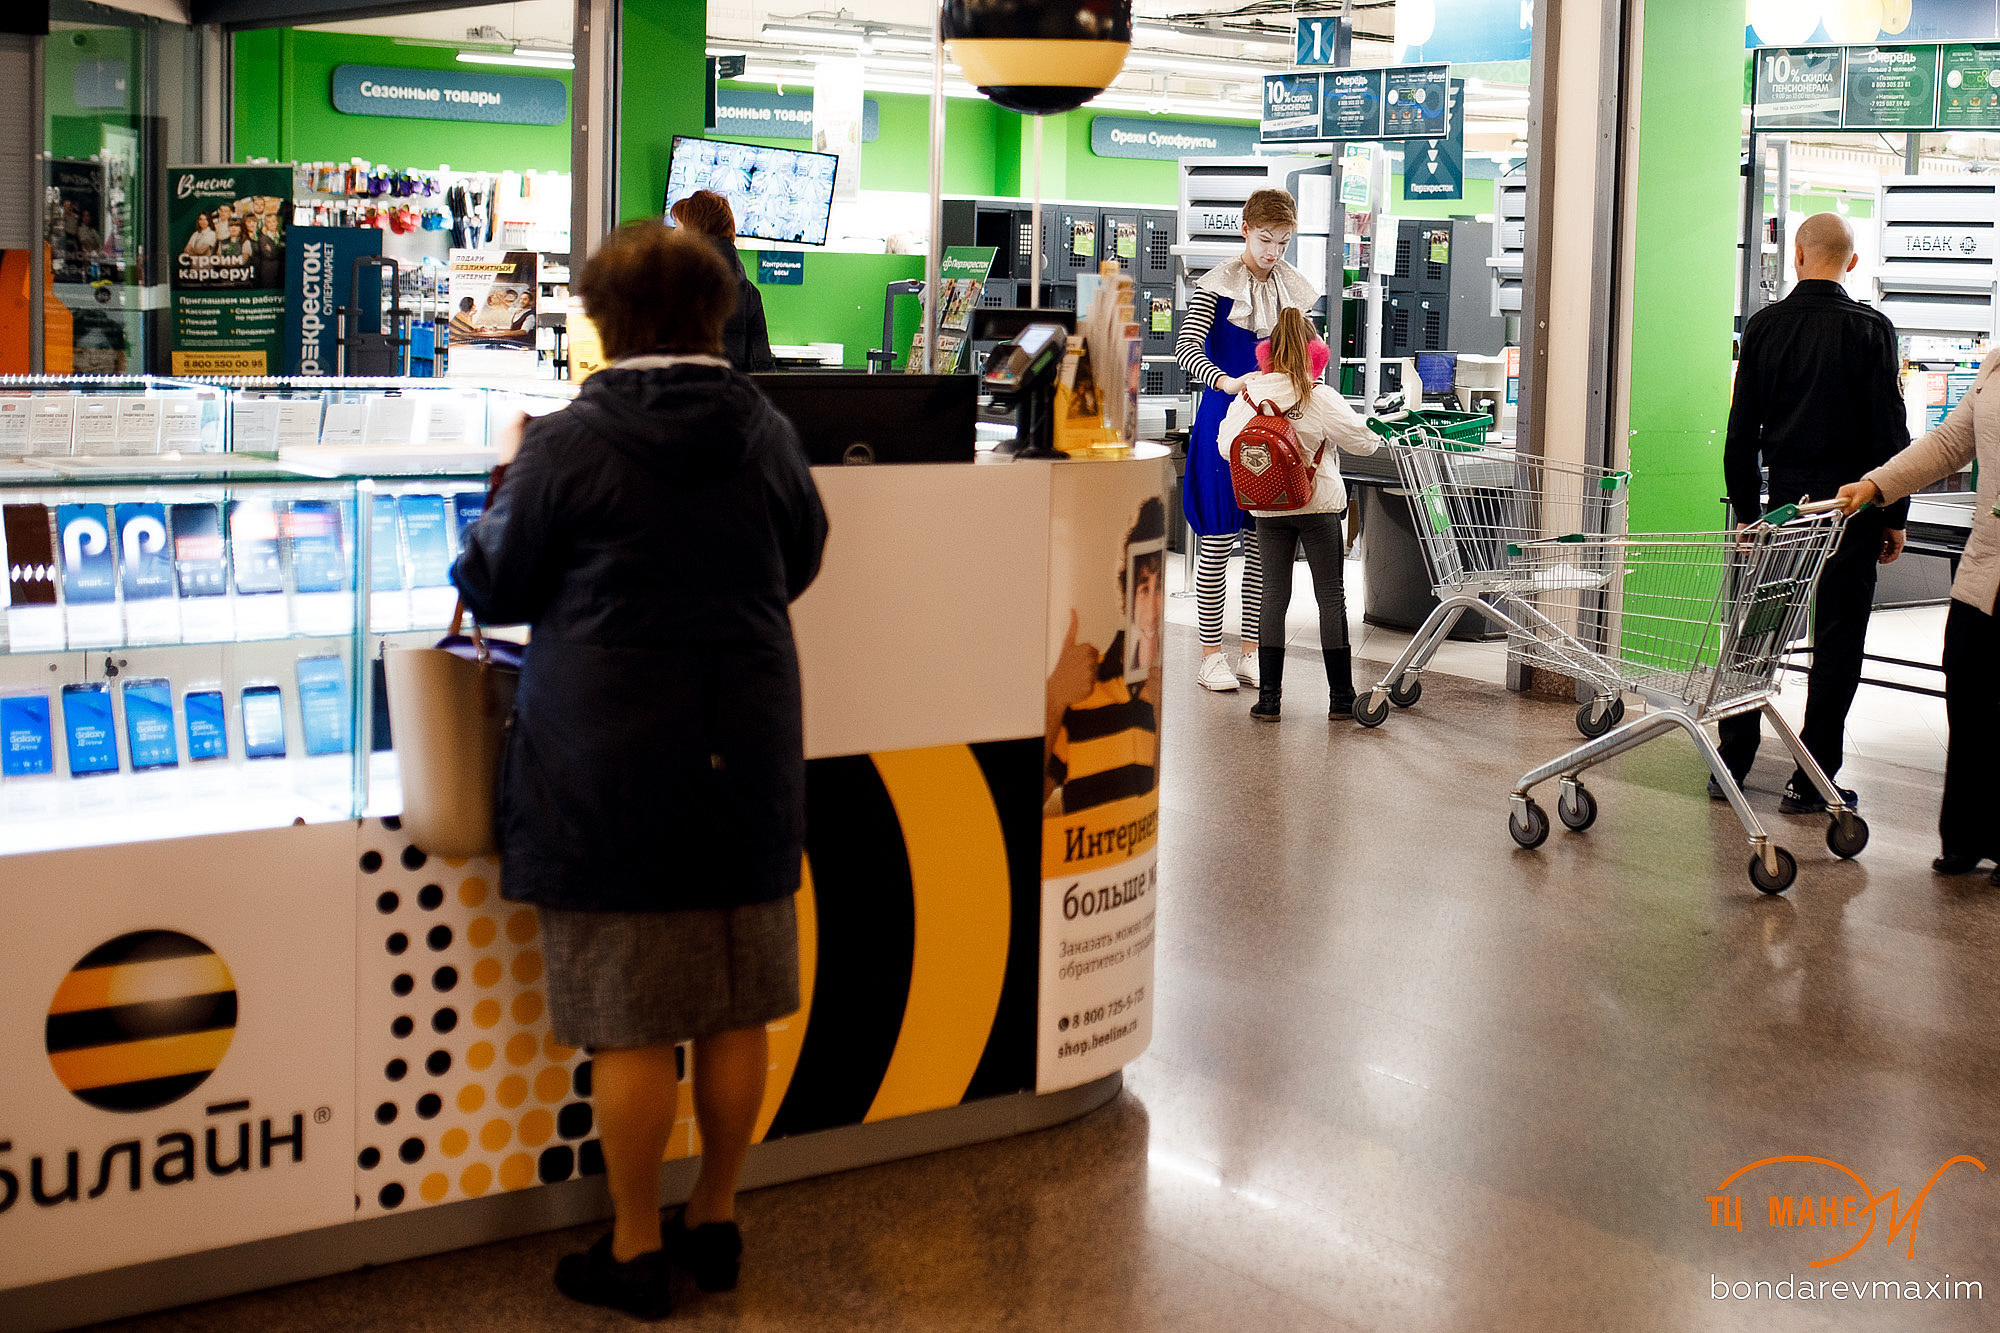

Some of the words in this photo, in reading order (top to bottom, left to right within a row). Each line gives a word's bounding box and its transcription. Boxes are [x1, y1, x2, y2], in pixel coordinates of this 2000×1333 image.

[1311, 22, 1322, 60] 1
[1869, 53, 1916, 65] Очередь
[1801, 74, 1833, 83] СКИДКА
[360, 81, 440, 101] Сезонные
[443, 88, 501, 107] товары
[1771, 84, 1829, 93] ПЕНСИОНЕРАМ
[1110, 128, 1147, 146] Орехи
[1148, 131, 1217, 150] Сухофрукты
[177, 173, 236, 199] Вместе
[1411, 183, 1454, 194] Перекресток
[1203, 213, 1239, 230] ТАБАК
[1905, 236, 1952, 251] ТАБАК
[178, 253, 243, 268] Строим
[455, 264, 512, 272] БЕЗЛИМИТНЫЙ
[178, 265, 255, 282] карьеру!
[322, 242, 334, 316] СУПЕРМАРКЕТ
[179, 296, 238, 306] Приглашаем
[1143, 291, 1151, 300] 17
[301, 241, 325, 377] рекресток
[192, 360, 212, 368] 800
[235, 360, 249, 368] 00
[460, 508, 482, 517] Gala
[9, 735, 42, 744] Galaxy
[75, 731, 106, 740] Galaxy
[1063, 872, 1145, 921] больше
[1059, 934, 1113, 960] Заказать
[1058, 950, 1125, 981] обратитесь
[1072, 1014, 1080, 1029] 8
[1083, 1006, 1105, 1026] 800
